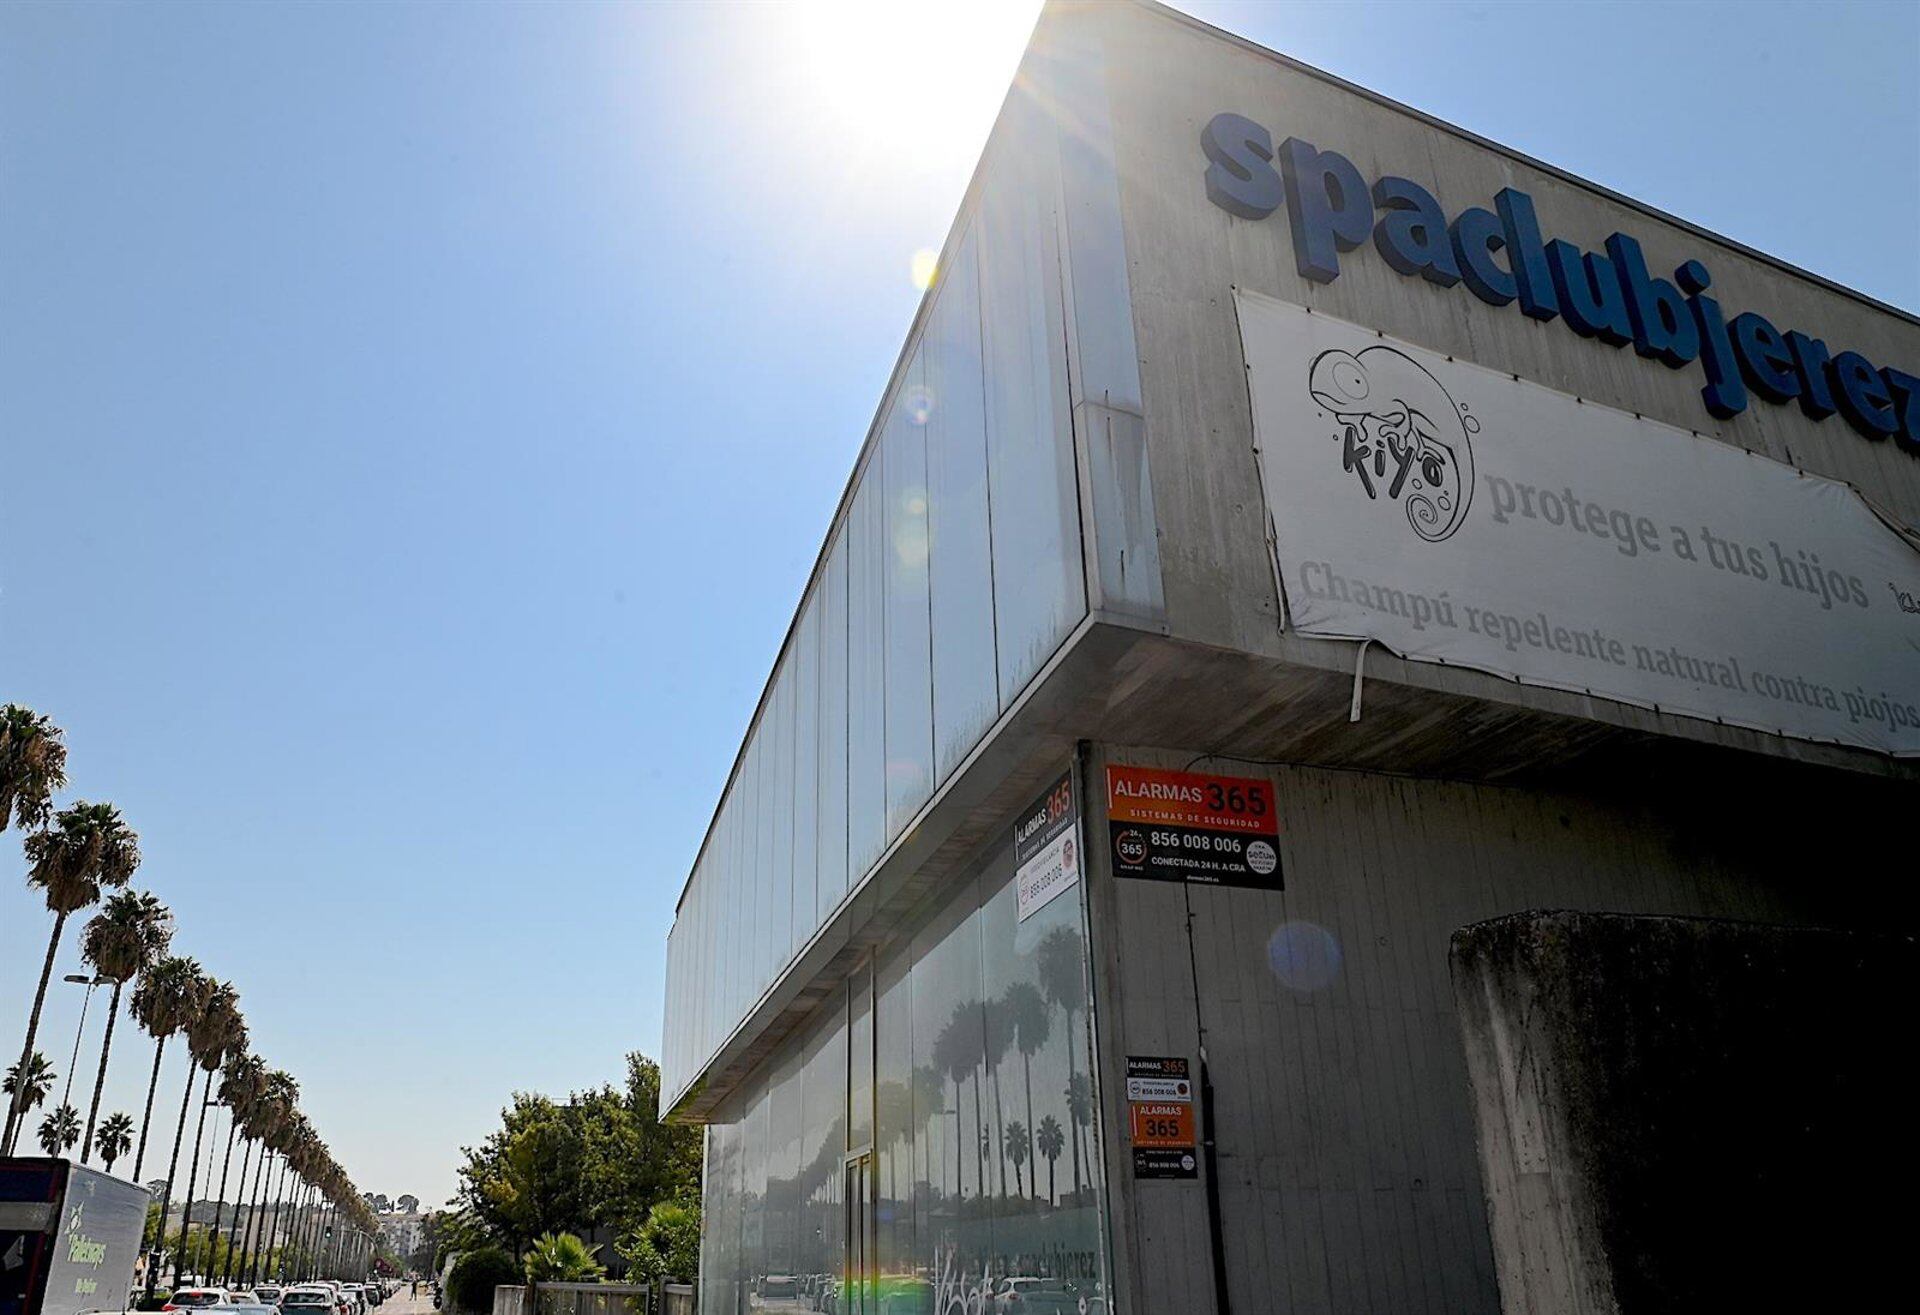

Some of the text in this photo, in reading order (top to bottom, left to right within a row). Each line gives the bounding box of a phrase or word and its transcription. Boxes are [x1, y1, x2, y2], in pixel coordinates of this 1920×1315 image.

[1484, 474, 1869, 610] protege a tus hijos
[1300, 561, 1920, 733] Champú repelente natural contra piojos
[1046, 780, 1070, 825] 365
[1114, 779, 1267, 817] ALARMAS 365
[1130, 809, 1260, 829] SISTEMAS DE SEGURIDAD
[1121, 843, 1143, 856] 365
[1151, 831, 1242, 853] 856 008 006
[1151, 856, 1200, 869] CONECTADA
[1129, 1061, 1185, 1073] ALARMAS 365
[1140, 1106, 1182, 1115] ALARMAS
[1146, 1119, 1179, 1137] 365
